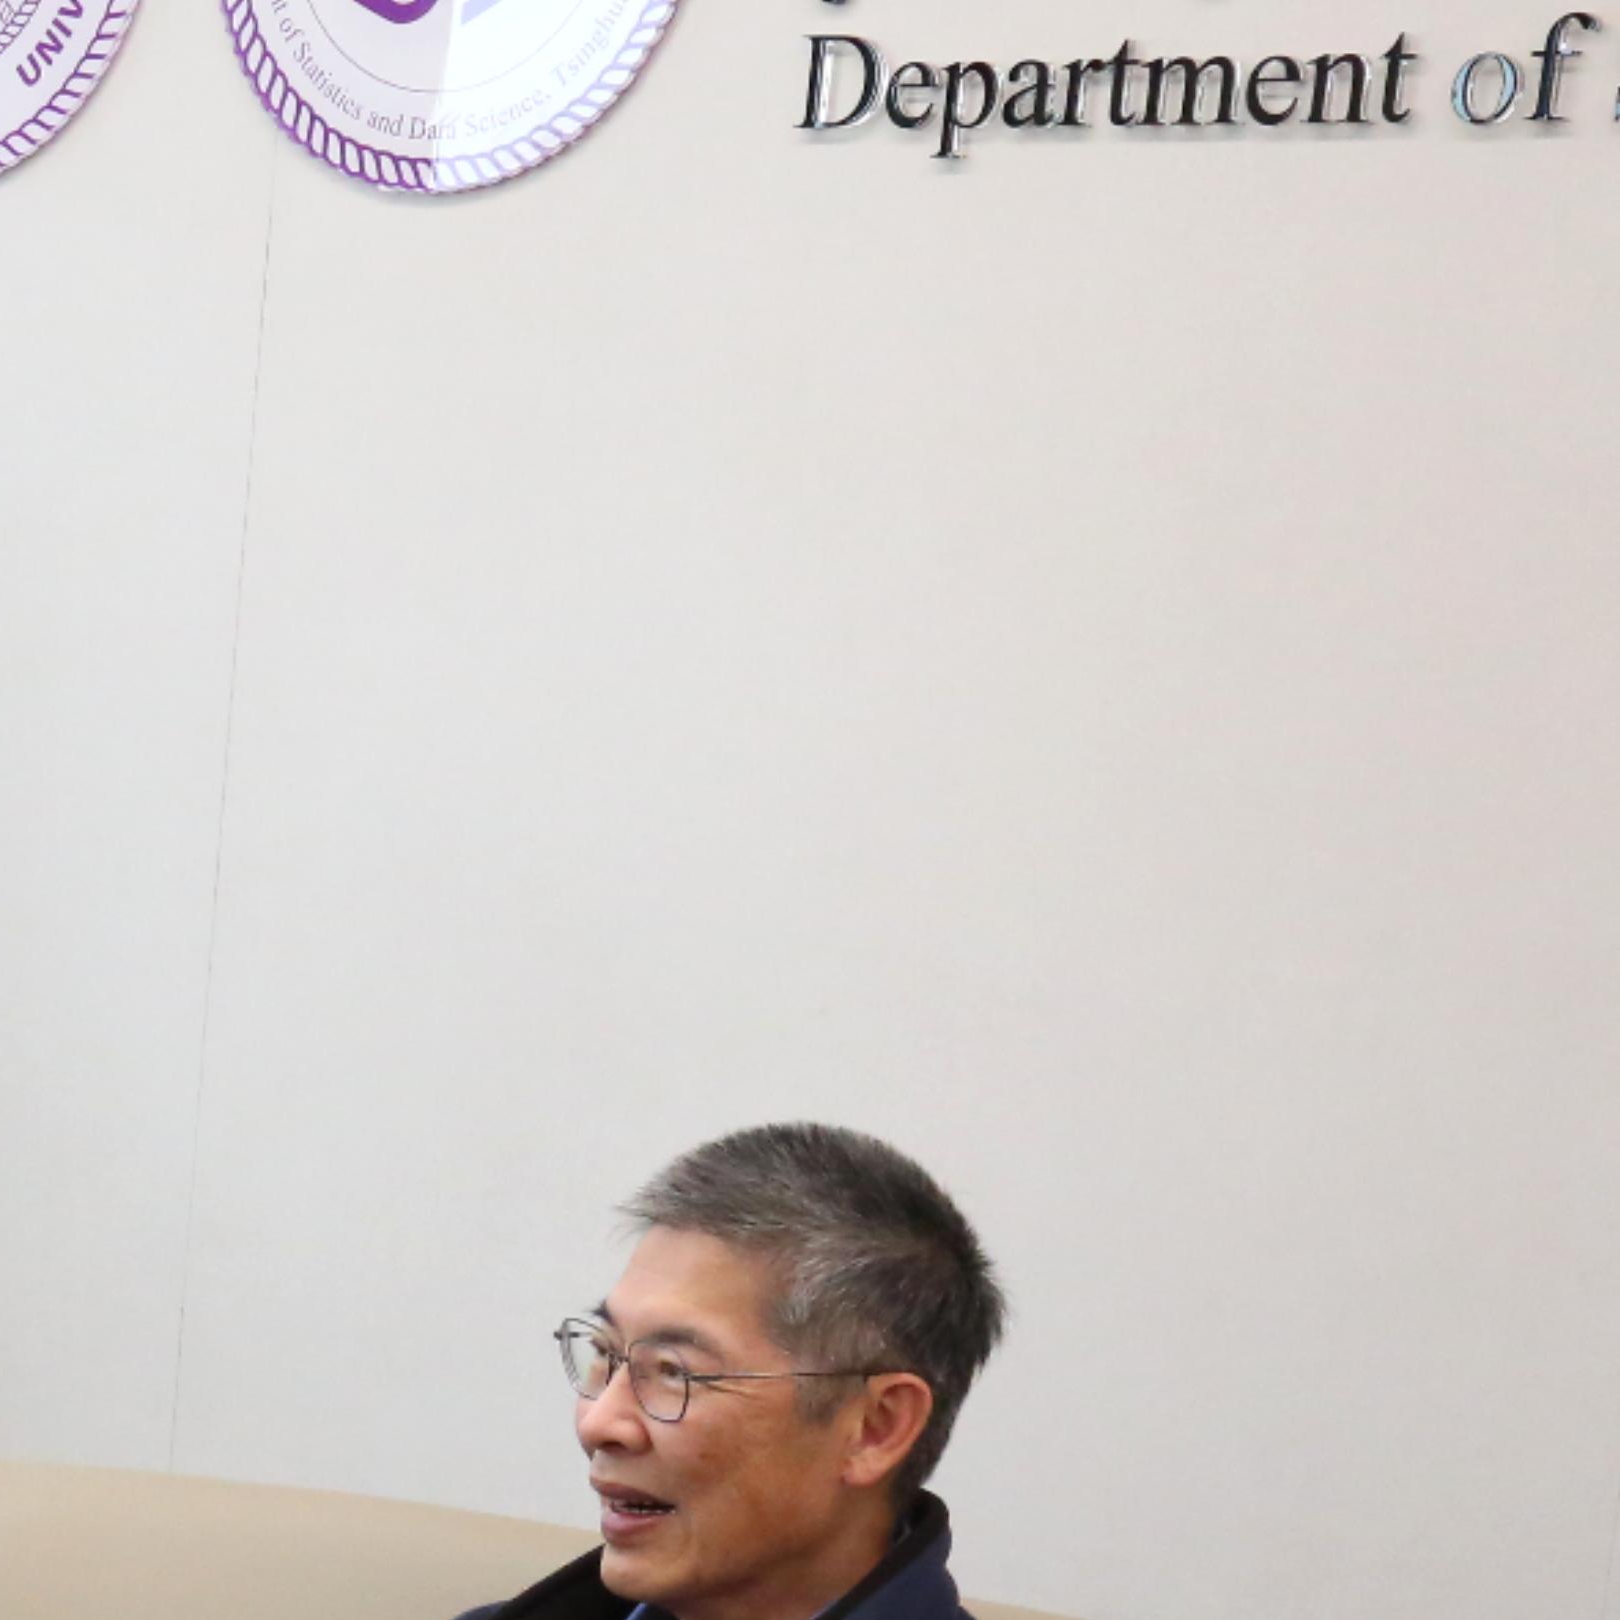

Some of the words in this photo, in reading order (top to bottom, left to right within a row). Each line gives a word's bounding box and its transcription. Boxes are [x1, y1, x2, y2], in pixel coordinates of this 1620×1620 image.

[279, 17, 305, 43] of
[292, 41, 364, 121] Statistics
[367, 110, 404, 137] and
[793, 31, 1418, 160] Department
[1450, 11, 1602, 126] of
